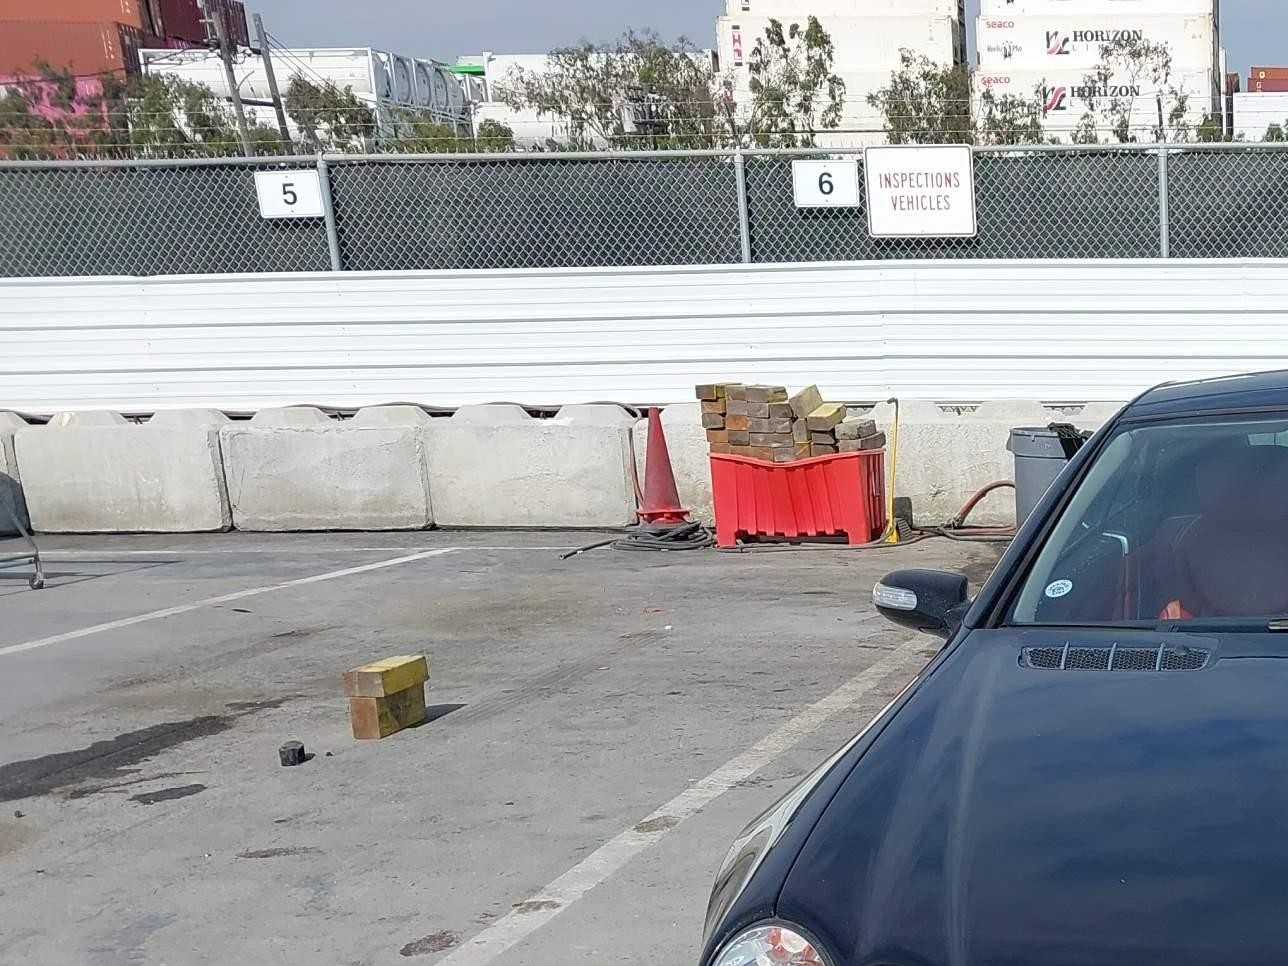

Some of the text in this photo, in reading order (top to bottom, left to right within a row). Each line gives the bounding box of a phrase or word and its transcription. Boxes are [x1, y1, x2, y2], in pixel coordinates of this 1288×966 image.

[986, 20, 1015, 29] seaco
[1072, 29, 1143, 42] HORIZON
[981, 76, 1010, 85] seaco
[1070, 85, 1140, 98] HORIZON
[818, 172, 834, 195] 6
[879, 171, 961, 189] INSPECTIONS
[282, 182, 297, 205] 5
[890, 194, 951, 211] VEHICLES
